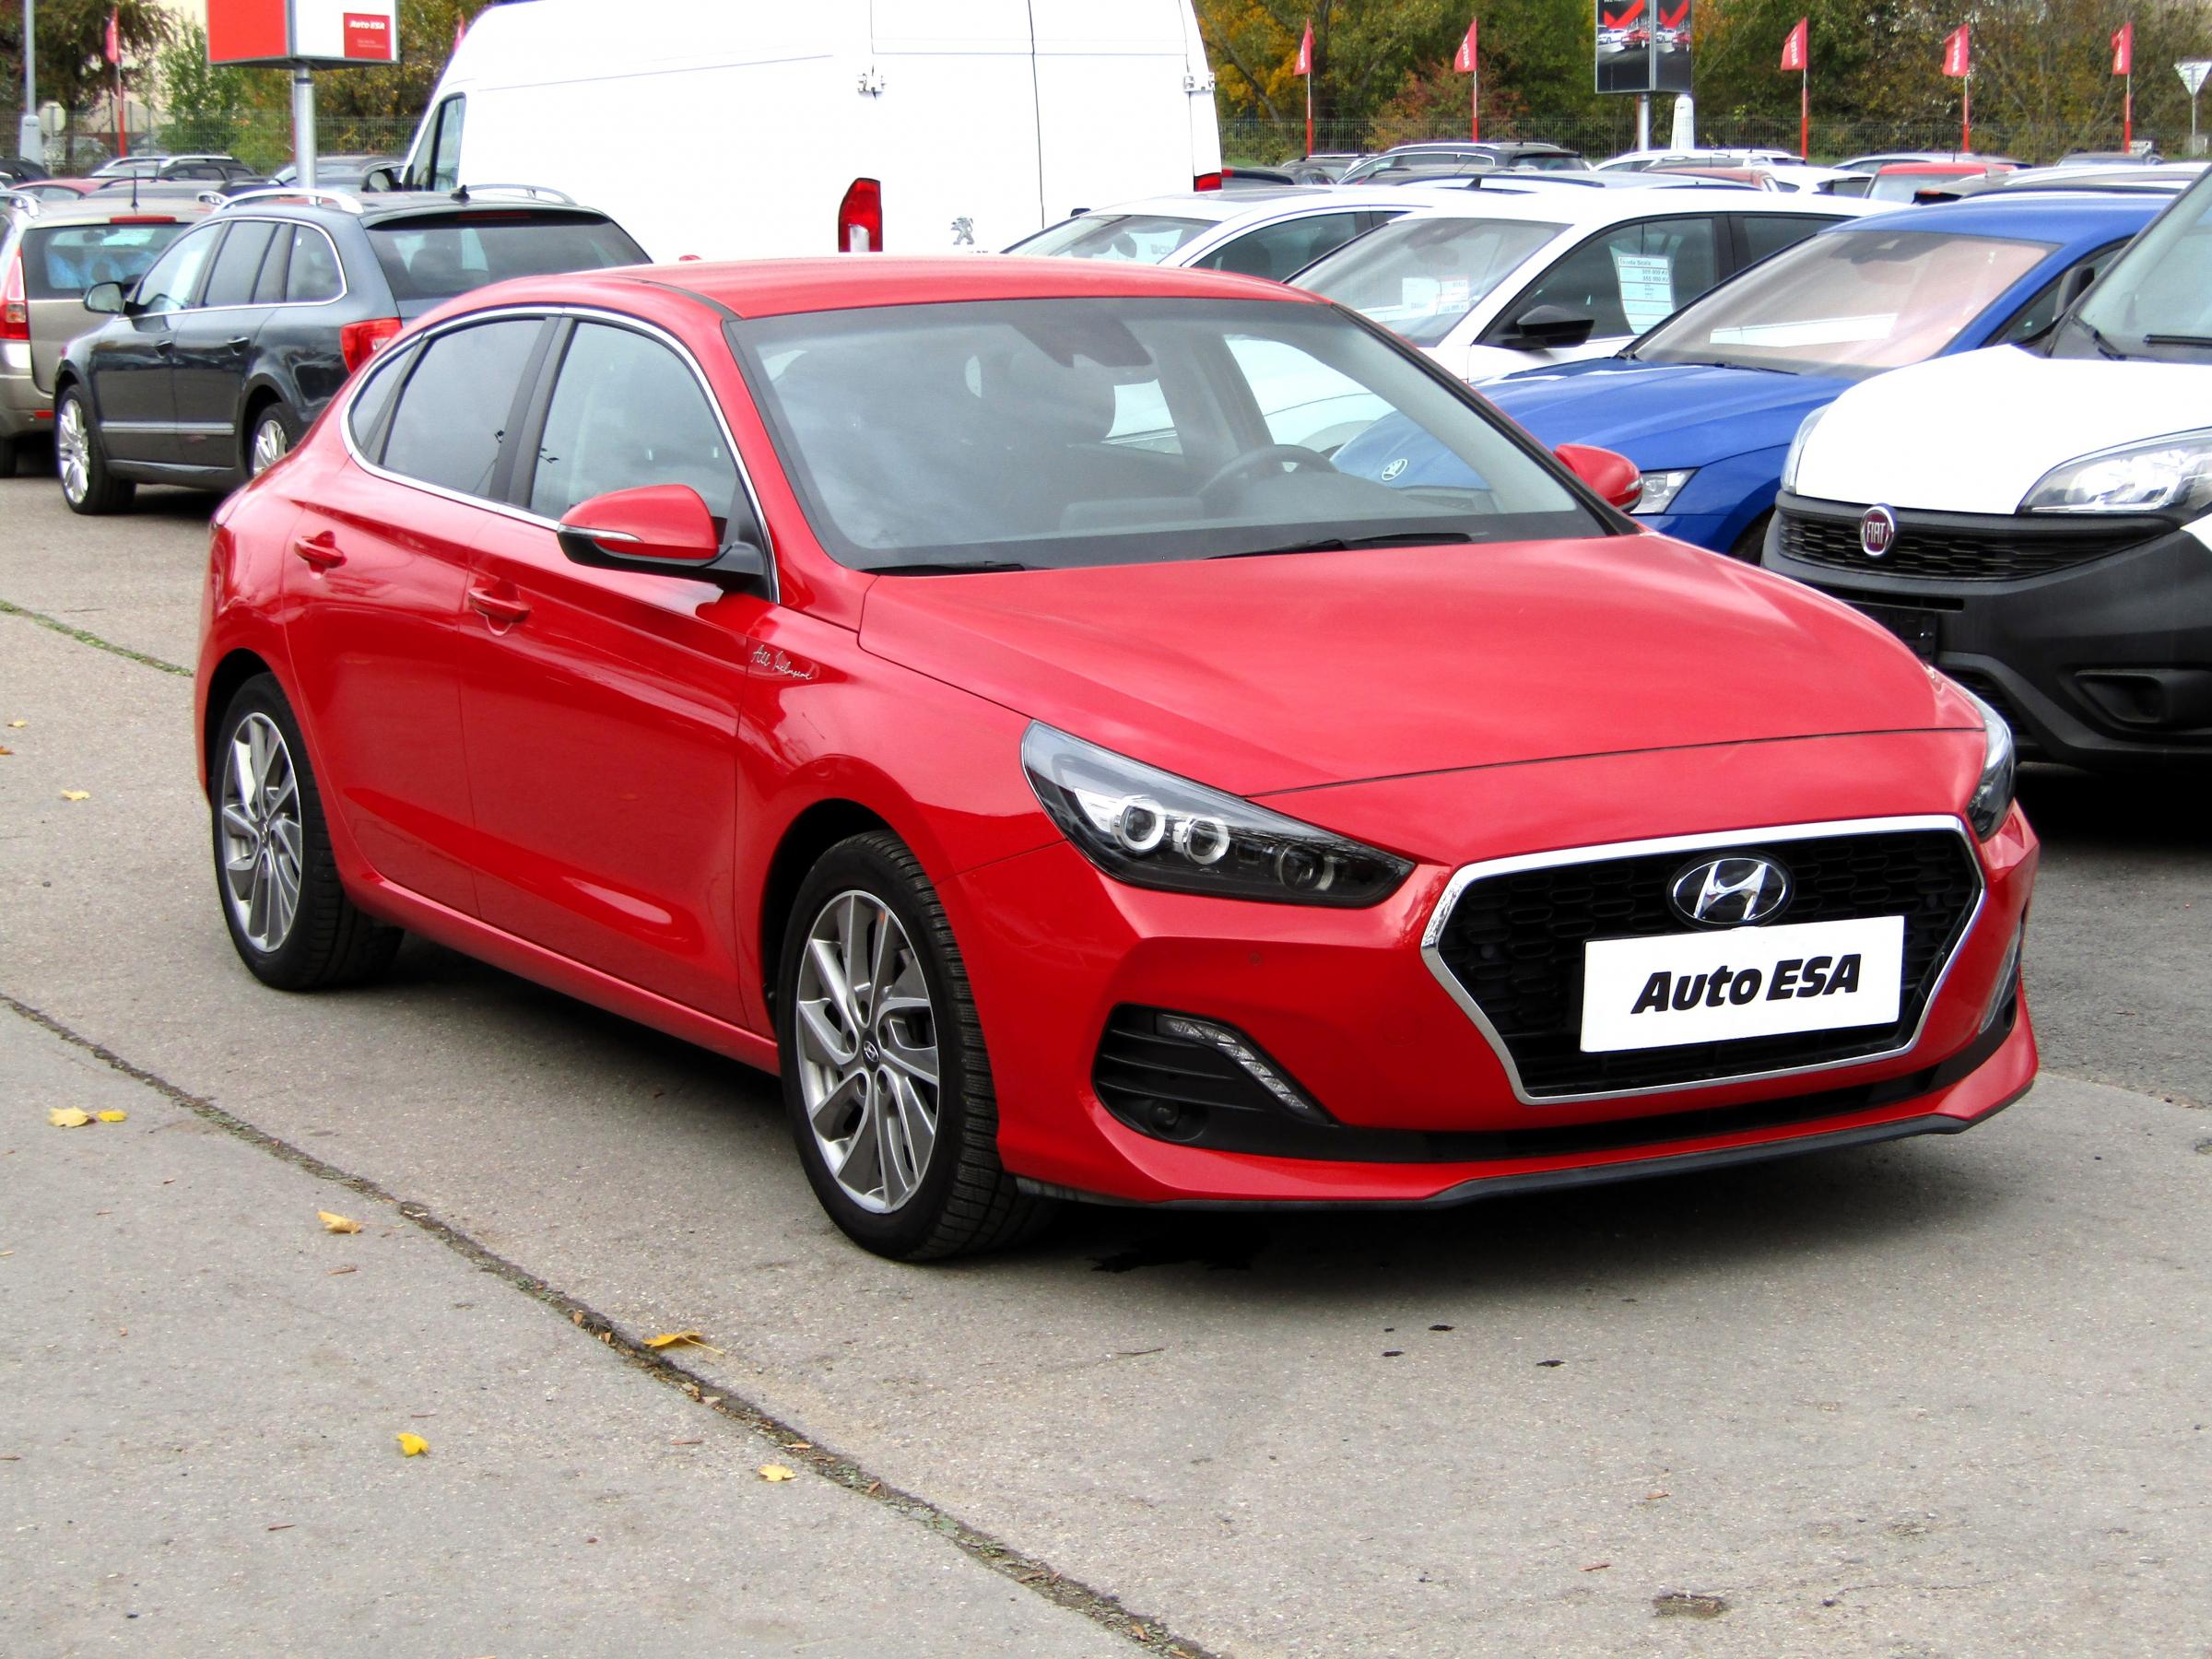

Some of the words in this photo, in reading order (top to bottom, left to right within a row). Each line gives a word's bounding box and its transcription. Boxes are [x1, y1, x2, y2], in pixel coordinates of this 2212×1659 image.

[349, 20, 370, 29] Auto
[1866, 522, 1886, 544] FIAT
[750, 644, 771, 666] All
[1630, 965, 1762, 1015] Auto
[1766, 953, 1862, 1001] ESA
